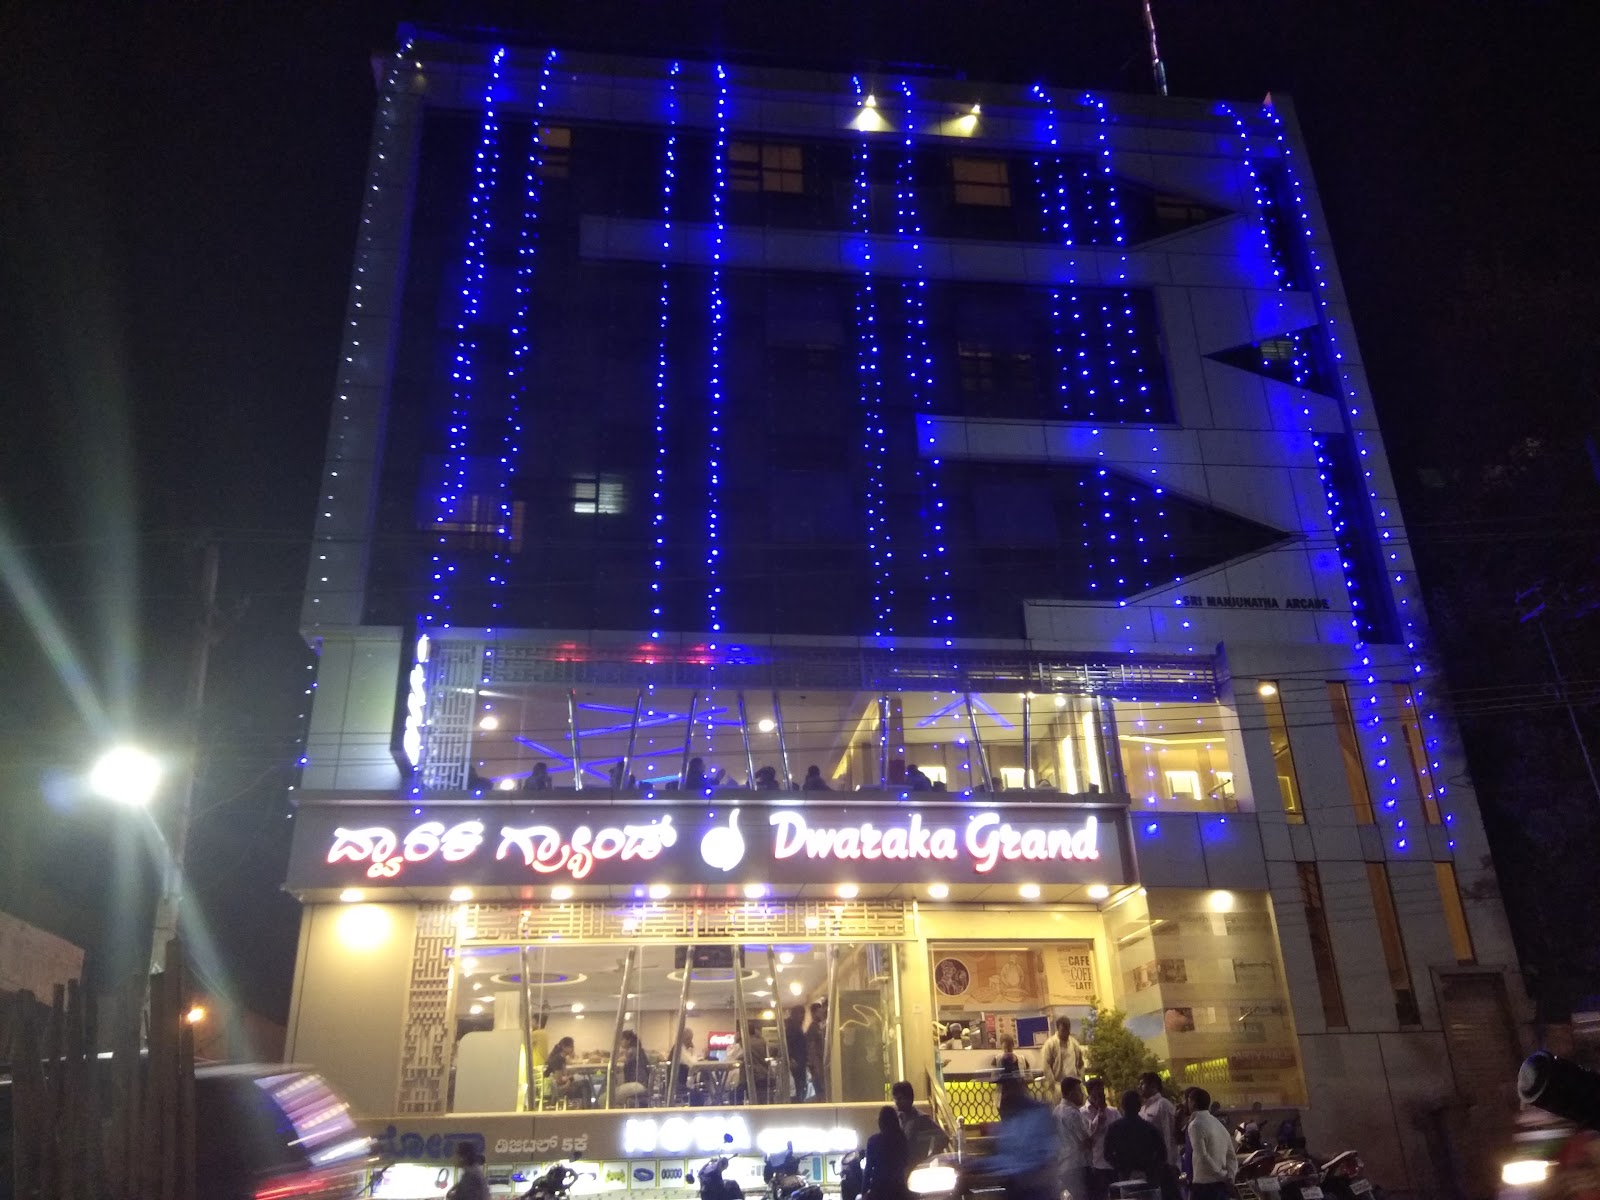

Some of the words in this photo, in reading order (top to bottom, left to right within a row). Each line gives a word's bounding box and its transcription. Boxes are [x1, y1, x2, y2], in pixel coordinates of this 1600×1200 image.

[1183, 596, 1202, 606] SRI
[1206, 596, 1279, 608] MANJUNATHA
[1286, 598, 1329, 609] ARCADE
[769, 810, 958, 859] Dwaraka
[965, 812, 1099, 873] Grand
[1068, 955, 1090, 966] CAFE
